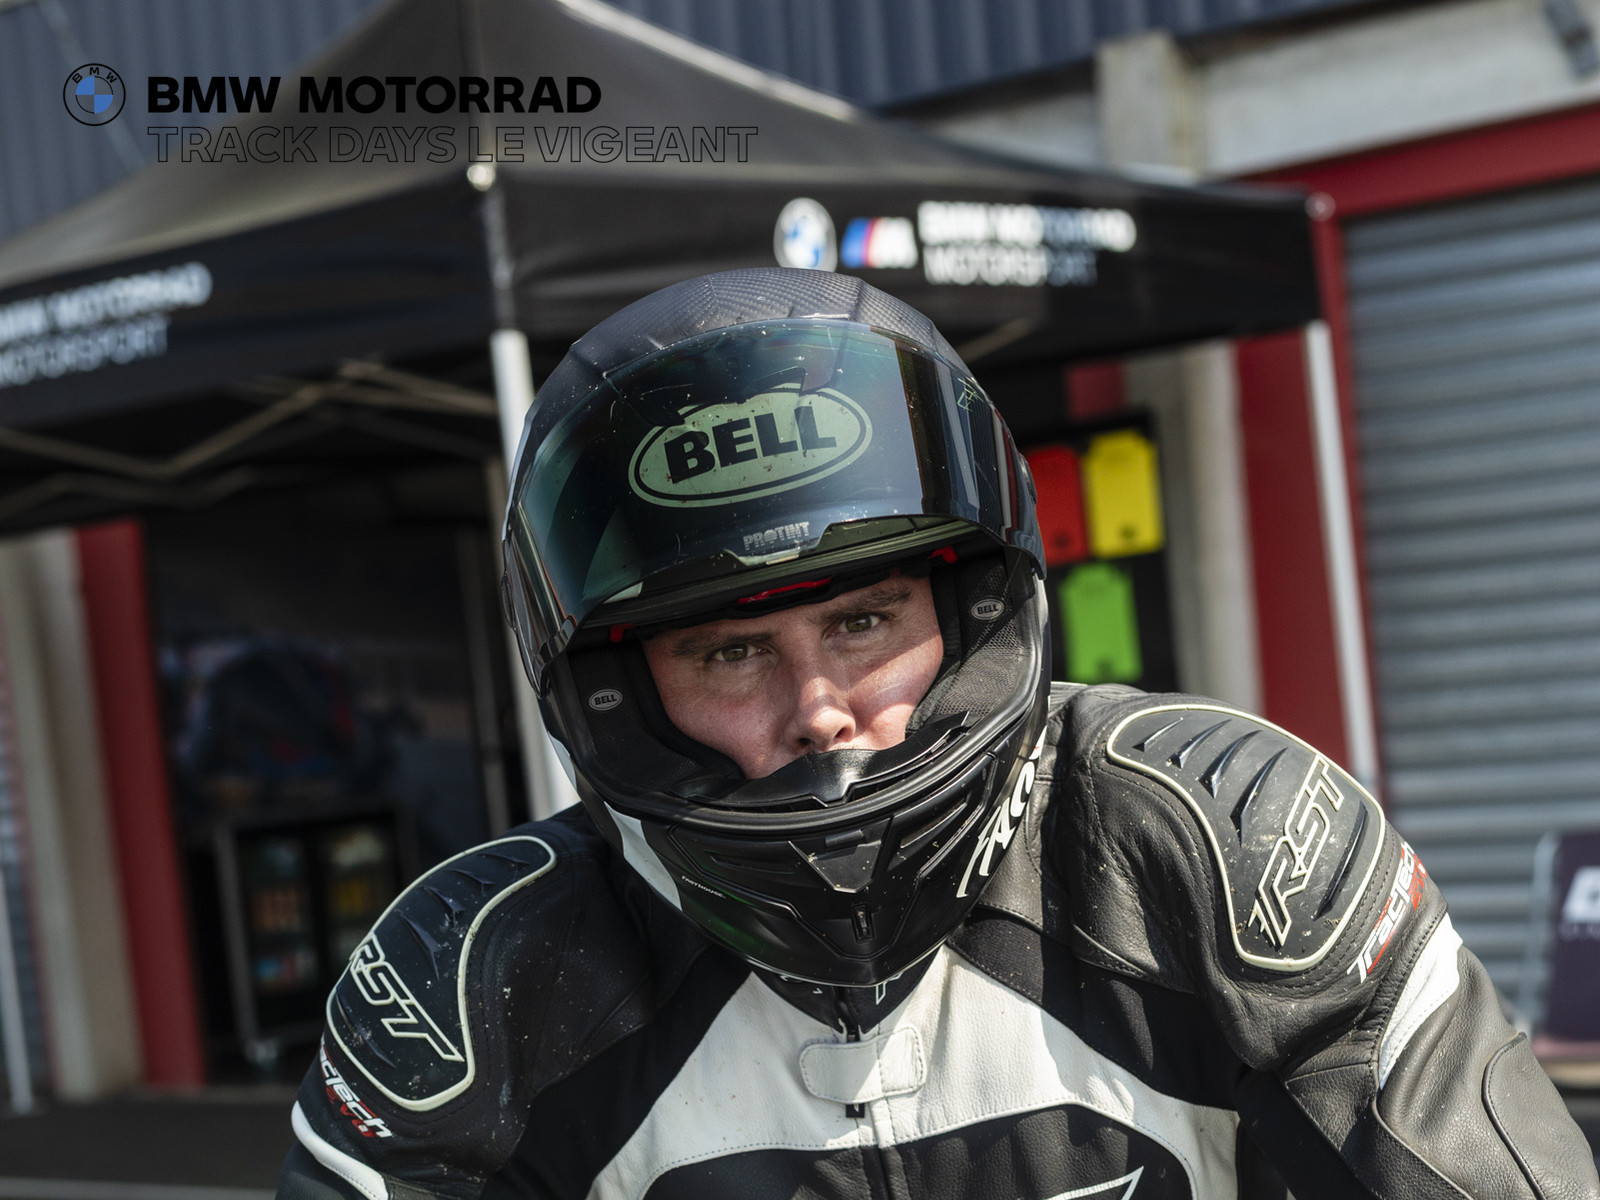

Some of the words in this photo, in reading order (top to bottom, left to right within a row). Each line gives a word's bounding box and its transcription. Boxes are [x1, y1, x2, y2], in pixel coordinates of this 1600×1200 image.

[664, 406, 837, 484] BELL
[742, 521, 810, 551] PROTINT
[977, 604, 998, 614] BELL
[594, 694, 617, 705] BELL
[1249, 755, 1344, 946] RST
[349, 929, 465, 1063] RST
